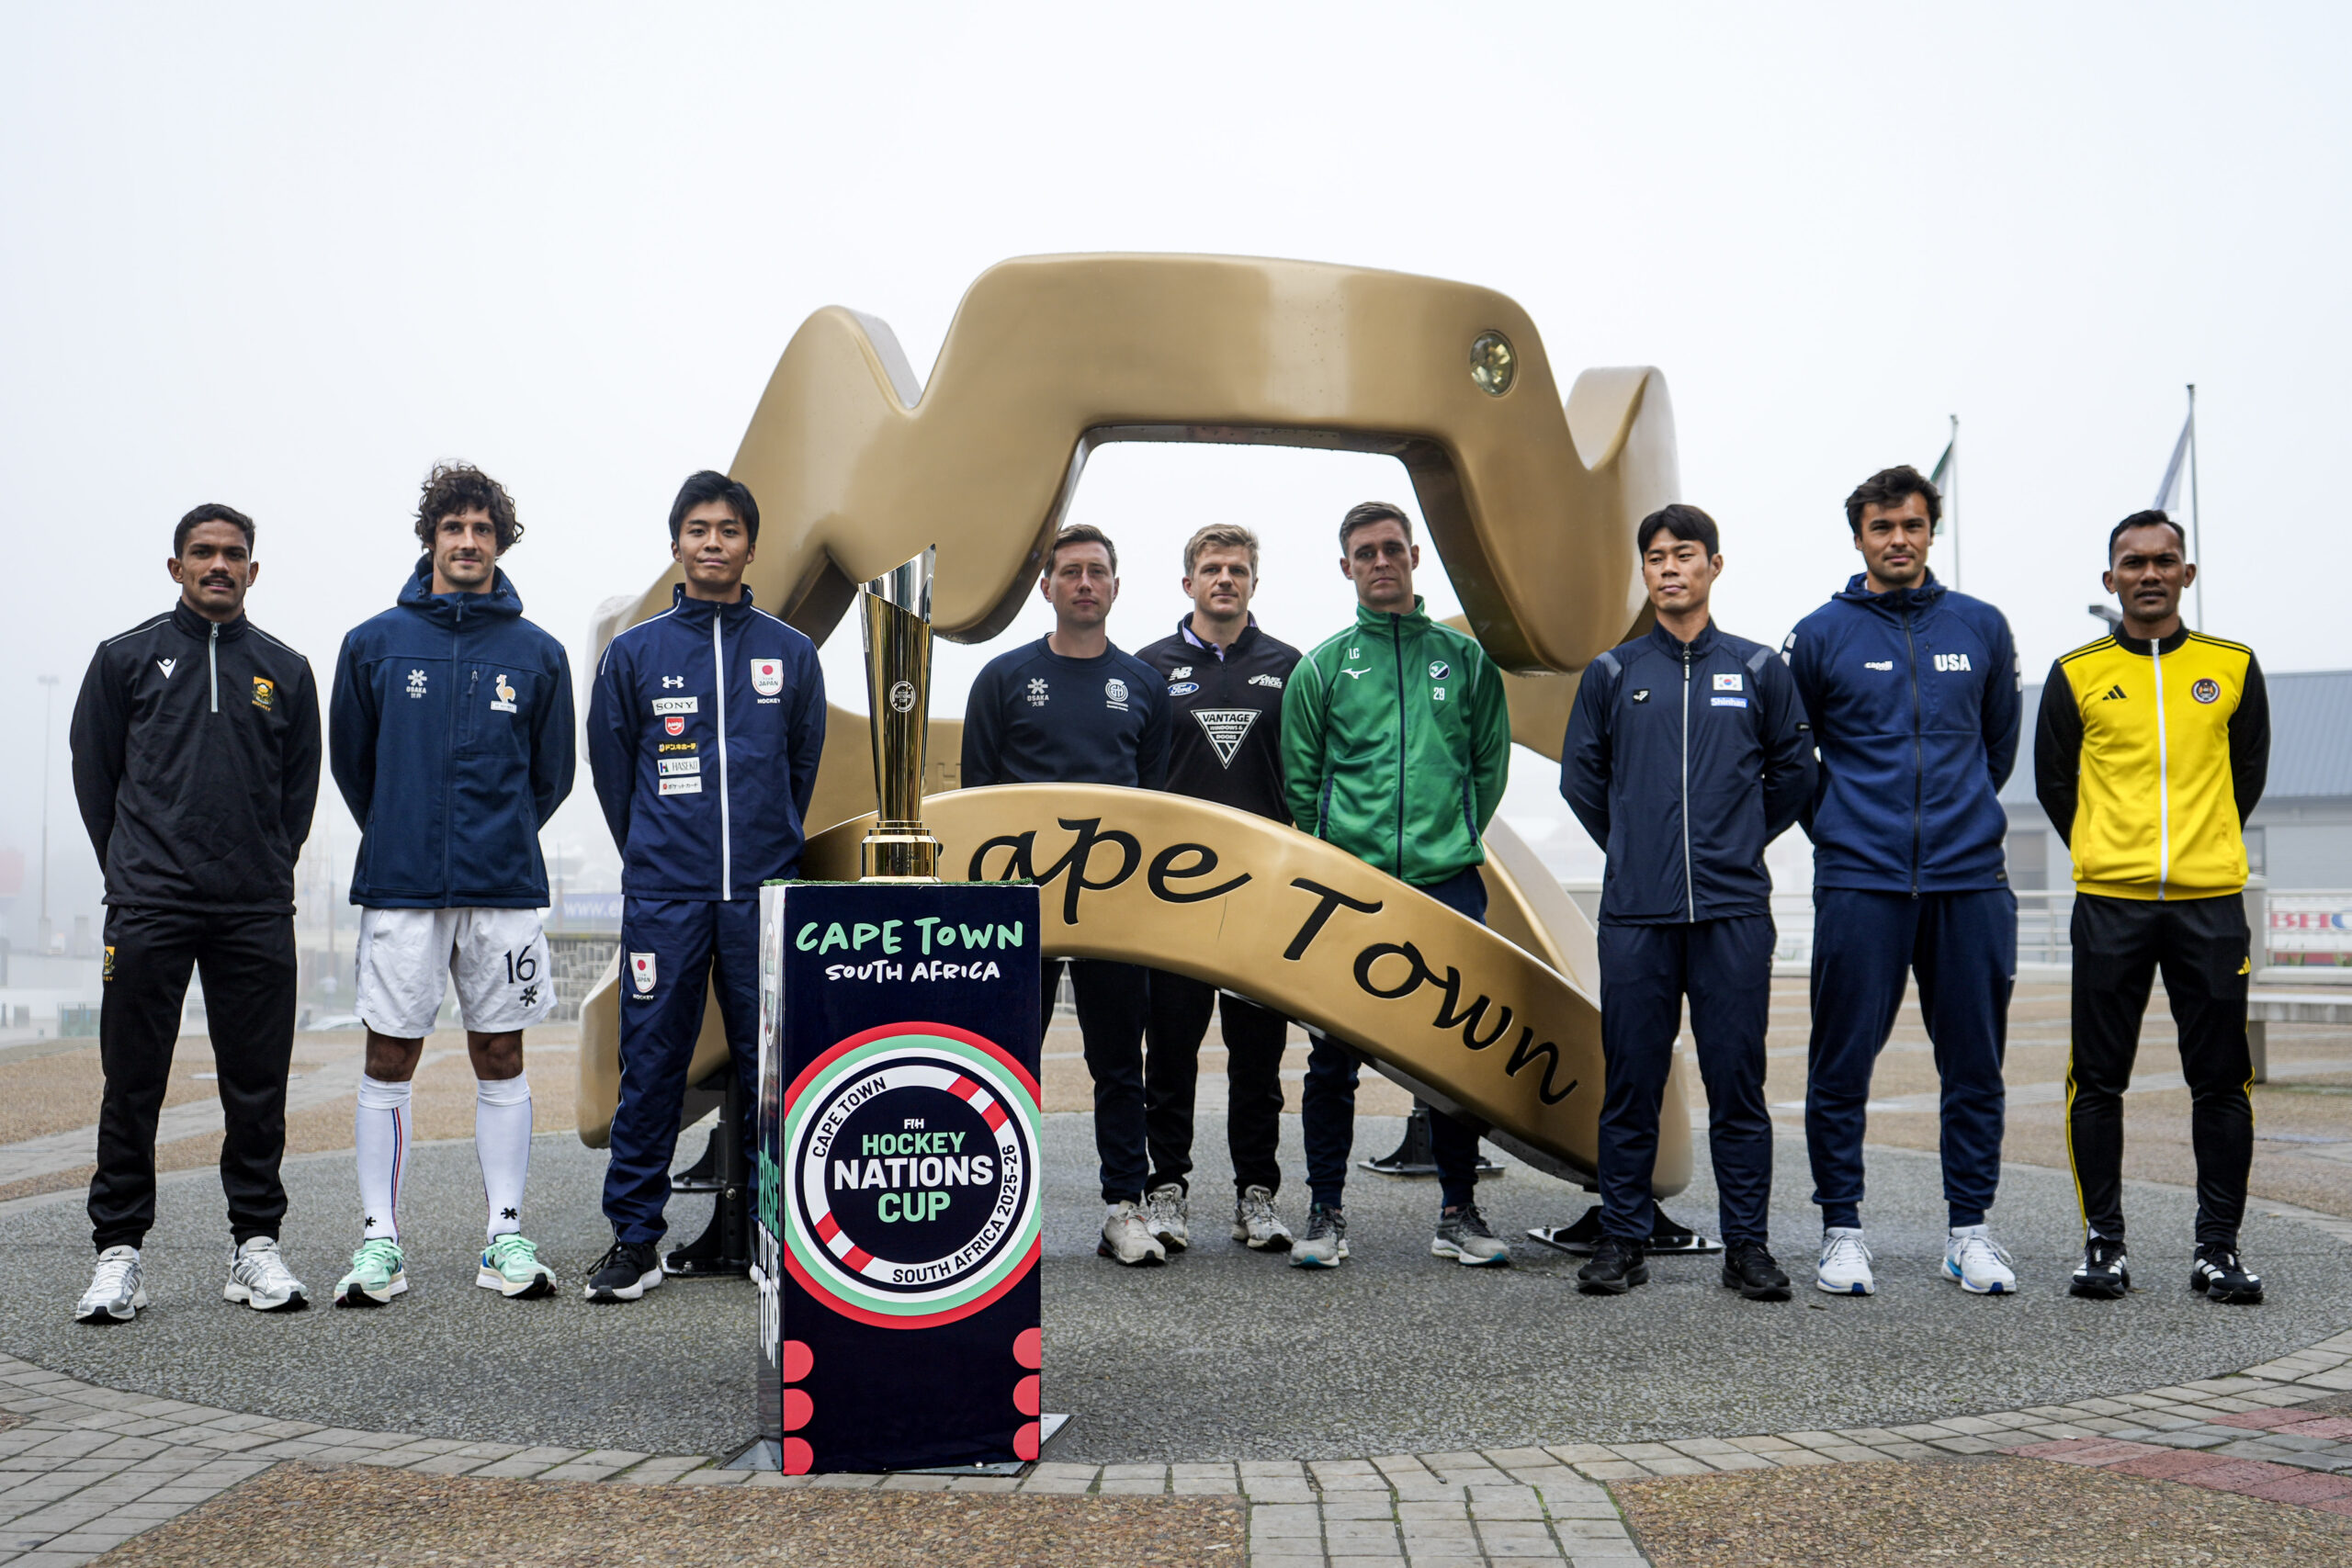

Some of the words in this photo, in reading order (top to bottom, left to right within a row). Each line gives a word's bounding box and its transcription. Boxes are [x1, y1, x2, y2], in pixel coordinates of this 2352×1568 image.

[1349, 648, 1360, 660] LC
[1934, 654, 1972, 672] USA
[406, 686, 426, 694] OSAKA
[1171, 684, 1193, 694] Ford
[1433, 686, 1445, 701] 29
[656, 702, 694, 711] SONY
[1711, 697, 1747, 708] Shinhan
[1203, 714, 1250, 723] VANTAGE
[672, 761, 698, 772] HASEKO
[796, 919, 903, 955] CAPE
[913, 917, 1023, 955] TOWN
[503, 943, 536, 984] 16
[825, 959, 902, 984] SOUTH
[910, 960, 1001, 983] AFRICA
[968, 817, 1252, 925] ape
[1283, 877, 1578, 1106] Town
[812, 1111, 843, 1158] CAPE
[837, 1077, 887, 1114] TOWN
[862, 1132, 966, 1156] HOCKEY
[834, 1155, 994, 1190] NATIONS
[758, 1132, 780, 1240] RISE
[877, 1191, 951, 1224] CUP
[892, 1261, 952, 1283] SOUTH
[955, 1218, 1005, 1270] AFRICA
[997, 1144, 1018, 1217] 2025-26
[758, 1219, 766, 1272] TO
[766, 1229, 780, 1291] THE
[758, 1266, 780, 1370] TOP
